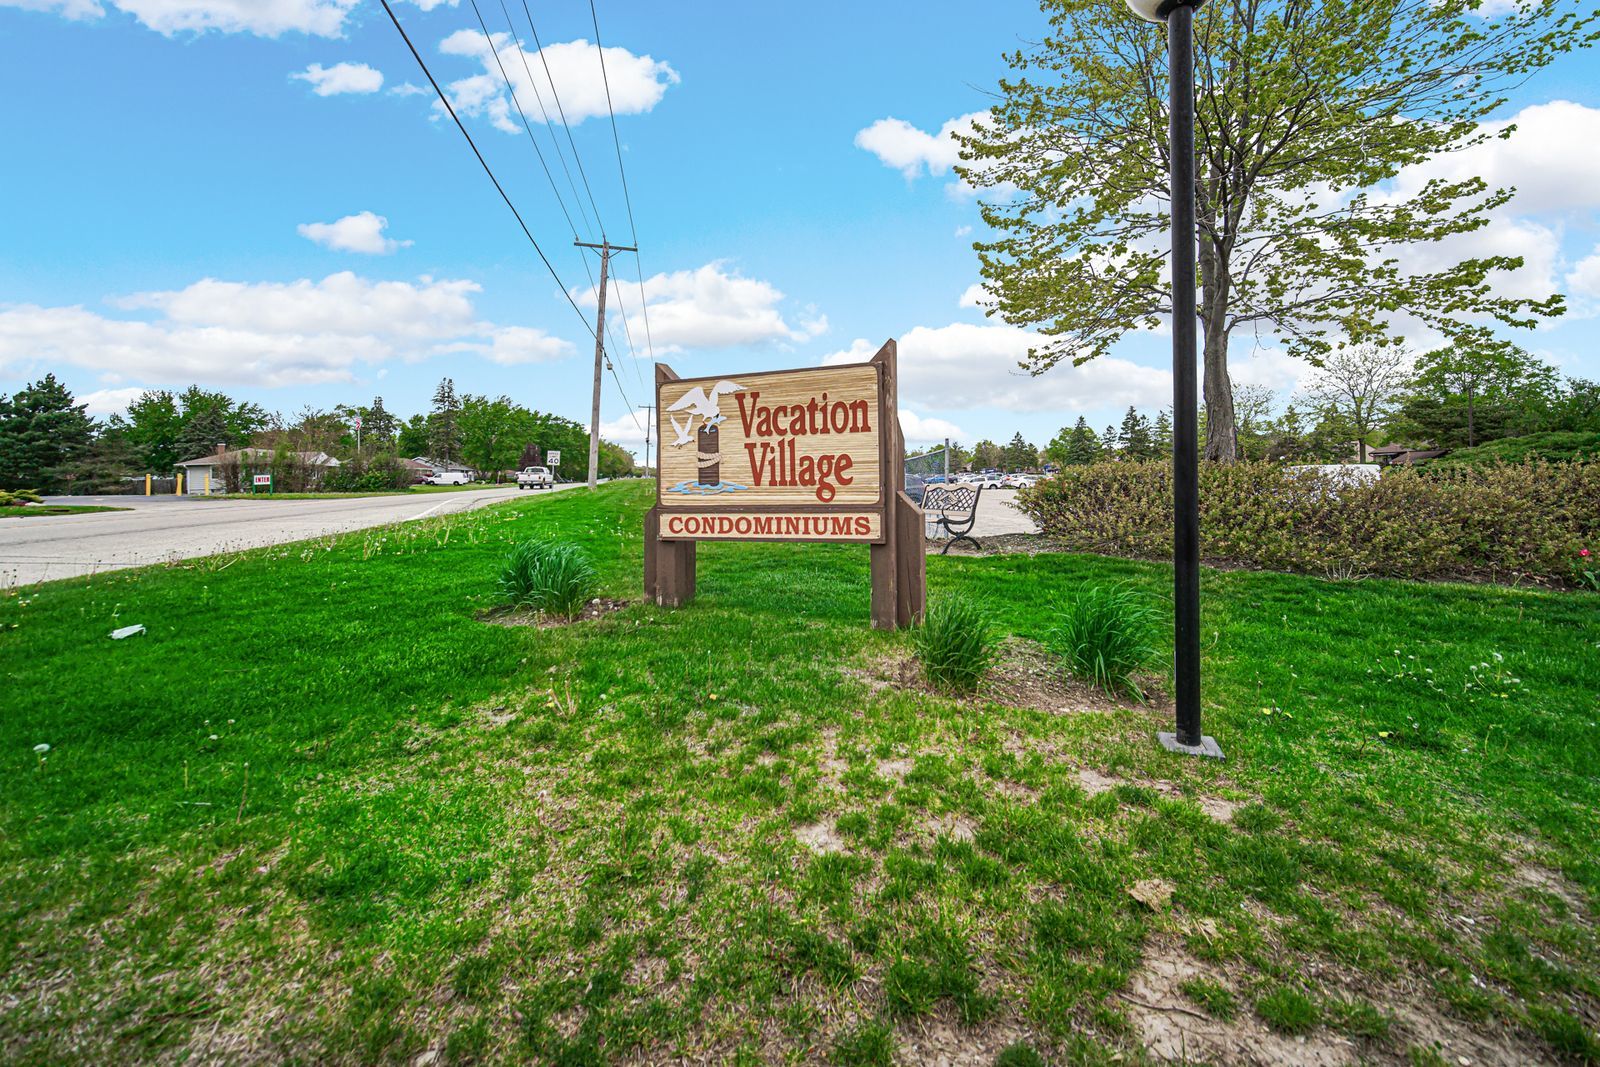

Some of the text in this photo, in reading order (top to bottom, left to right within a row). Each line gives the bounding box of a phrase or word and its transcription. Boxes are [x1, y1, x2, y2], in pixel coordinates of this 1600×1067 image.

[734, 391, 872, 438] Vacation
[744, 437, 854, 503] Village
[668, 516, 871, 535] CONDOMINIUMS
